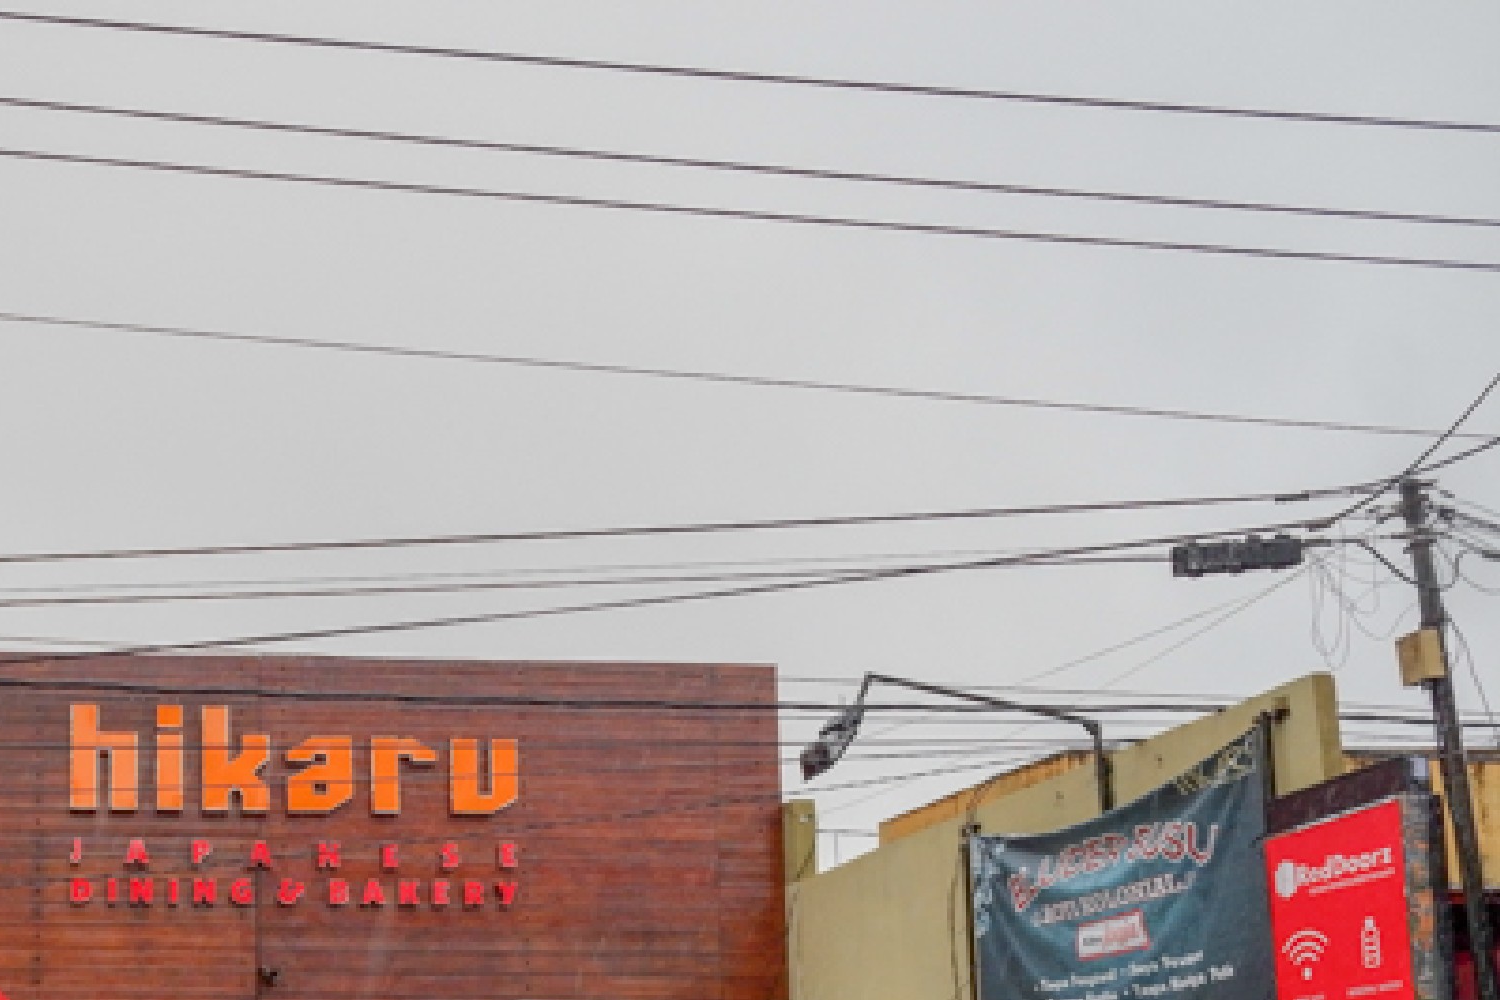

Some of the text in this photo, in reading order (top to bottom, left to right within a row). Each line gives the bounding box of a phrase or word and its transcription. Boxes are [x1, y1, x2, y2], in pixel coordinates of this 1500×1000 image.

[69, 704, 519, 813] hikaru
[69, 838, 518, 869] JAPANESE
[69, 877, 518, 905] DINING & BAKERY
